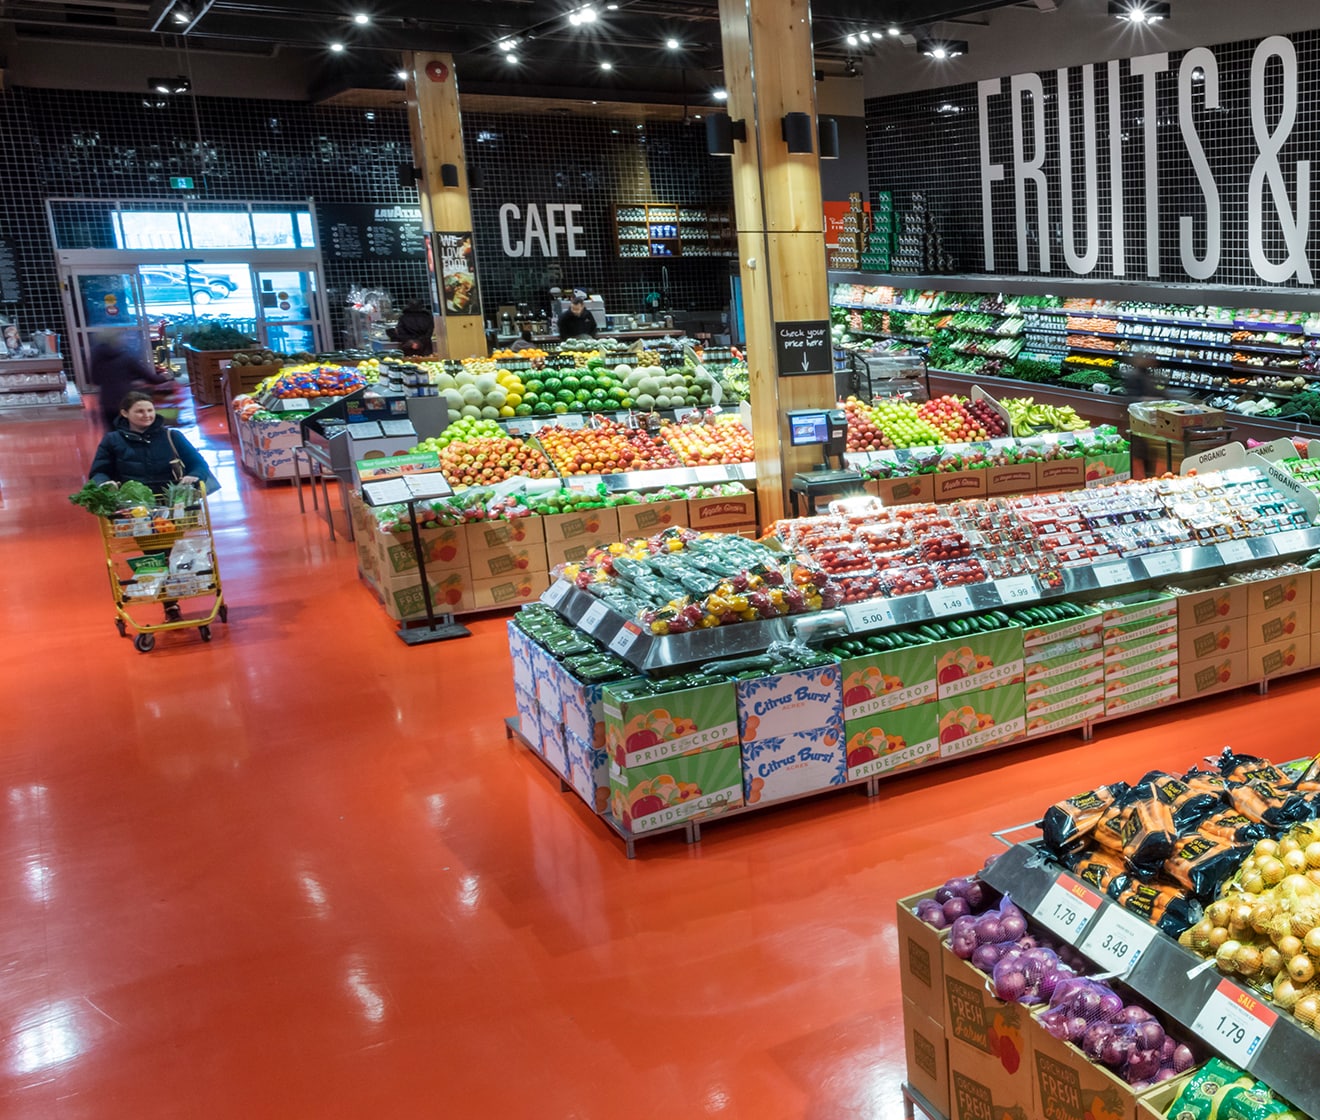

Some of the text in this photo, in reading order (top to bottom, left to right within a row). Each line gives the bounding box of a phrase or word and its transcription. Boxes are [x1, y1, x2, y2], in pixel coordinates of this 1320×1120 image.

[978, 47, 1220, 280] FRUITS
[1247, 35, 1315, 285] &
[439, 234, 458, 247] WE
[499, 203, 587, 257] CAFE
[441, 247, 466, 259] LOVE
[443, 258, 468, 270] FOOD
[780, 328, 826, 339] Check your
[784, 339, 823, 349] price here
[1199, 449, 1227, 464] ORGANIC
[1268, 467, 1300, 493] ORGANIC
[943, 600, 962, 609] 1.49
[1010, 588, 1029, 598] 3.99
[862, 614, 883, 625] 5.00
[945, 664, 1018, 694] PRIDE CROP
[754, 686, 831, 716] Citrus Burst
[852, 684, 929, 716] PRIDE CROP
[635, 727, 729, 763] PRIDE CROP
[947, 722, 1018, 753] PRIDE CROP
[758, 747, 835, 778] Citrus Burst
[855, 743, 932, 777] PRIDE CROP
[641, 791, 733, 829] PRIDE CROP
[1071, 884, 1086, 898] SALE
[1053, 903, 1076, 926] 1.79
[1102, 934, 1129, 958] 3.49
[951, 996, 984, 1026] FRESH
[1237, 993, 1257, 1012] SALE
[1216, 1015, 1246, 1044] 1.79
[1041, 1073, 1080, 1109] FRESH
[959, 1091, 991, 1120] FRESH
